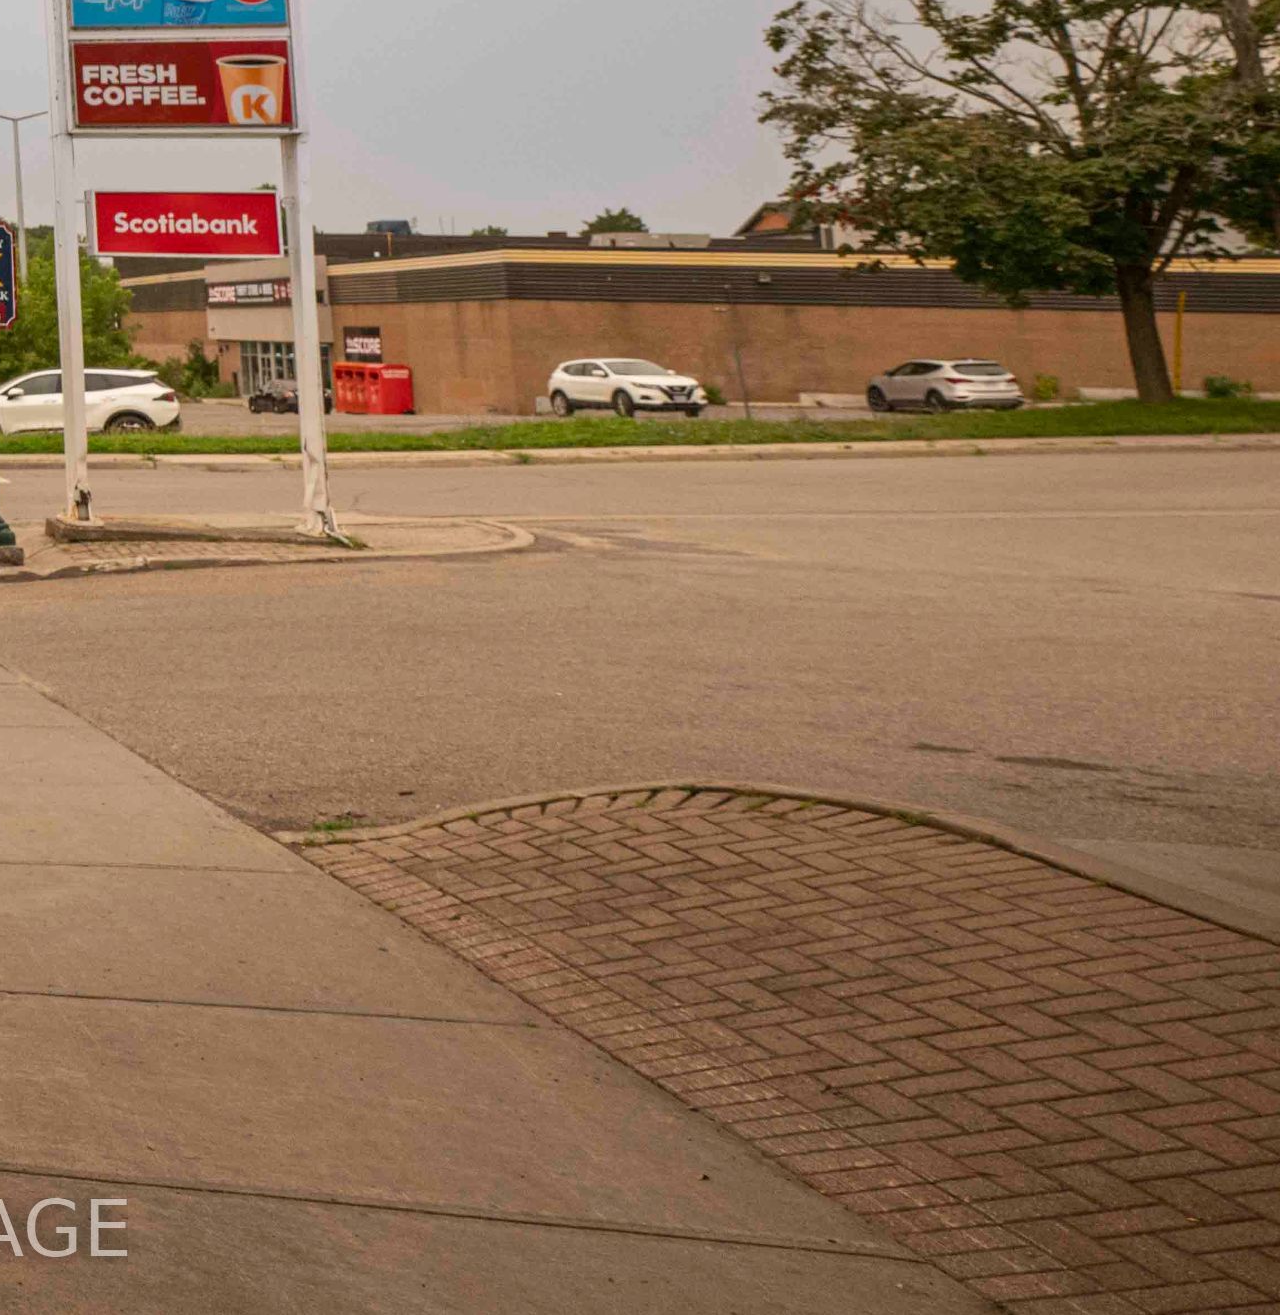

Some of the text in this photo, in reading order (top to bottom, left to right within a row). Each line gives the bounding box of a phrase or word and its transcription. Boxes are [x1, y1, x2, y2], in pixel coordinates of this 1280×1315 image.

[82, 64, 177, 85] FRESH
[83, 85, 207, 106] COFFEE.
[114, 212, 258, 235] Scotiabank
